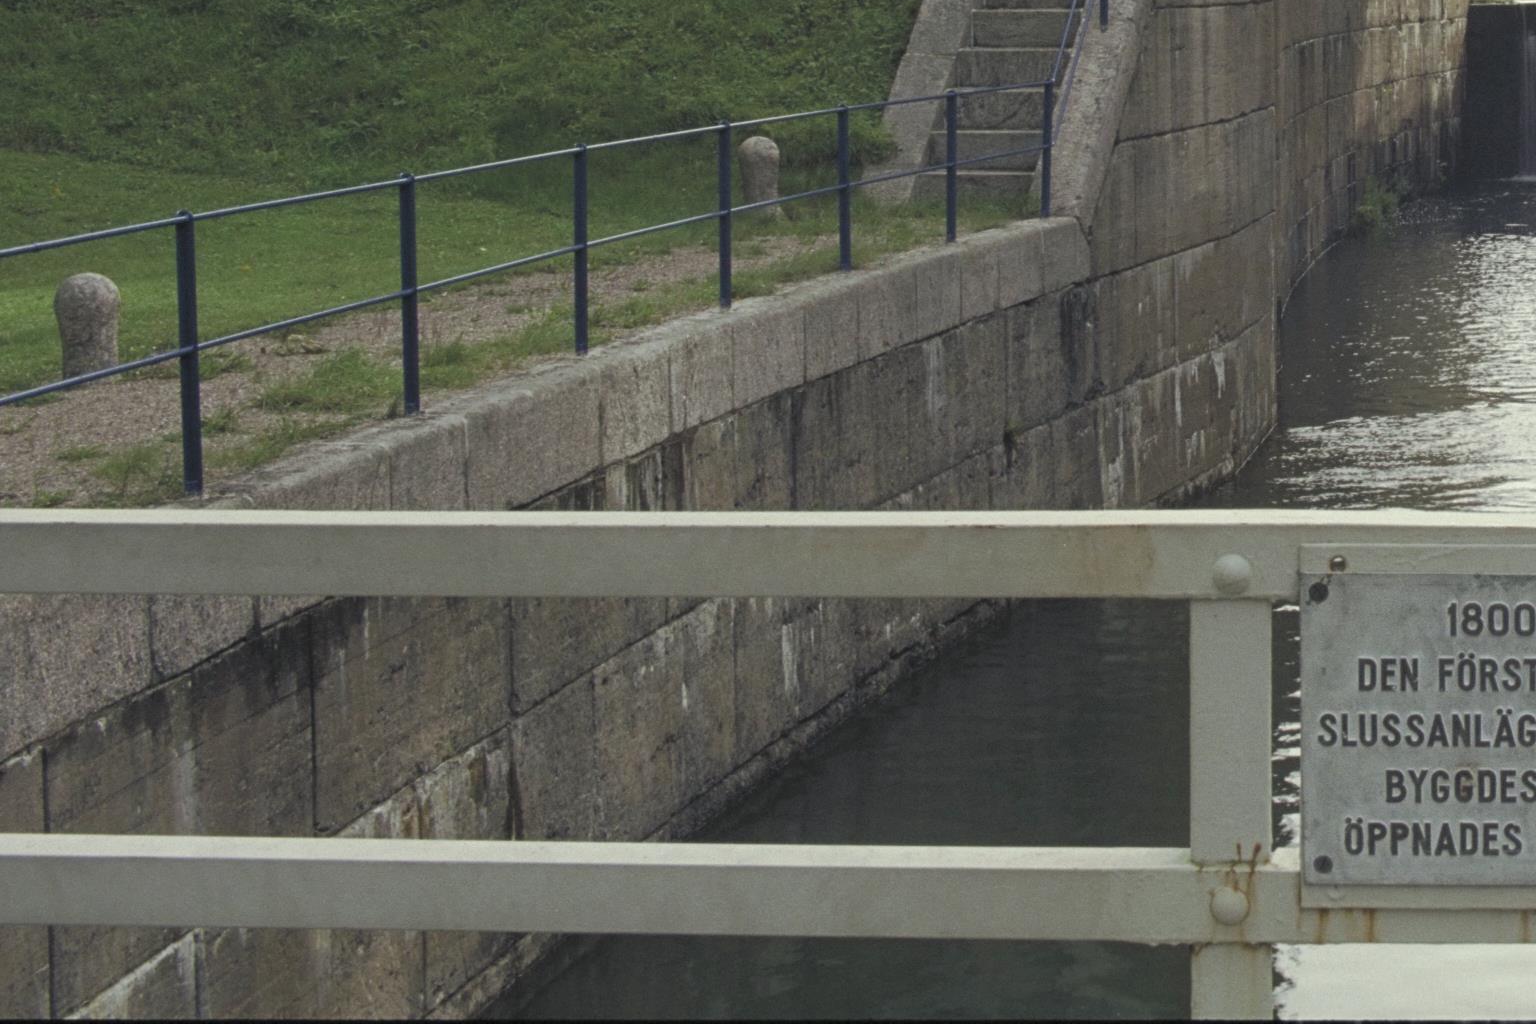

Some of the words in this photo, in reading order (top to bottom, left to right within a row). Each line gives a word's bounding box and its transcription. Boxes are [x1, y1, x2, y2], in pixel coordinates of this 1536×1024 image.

[1447, 602, 1536, 638] 1800
[1357, 657, 1419, 692] DEN
[1344, 817, 1523, 857] ÖPPNADES
